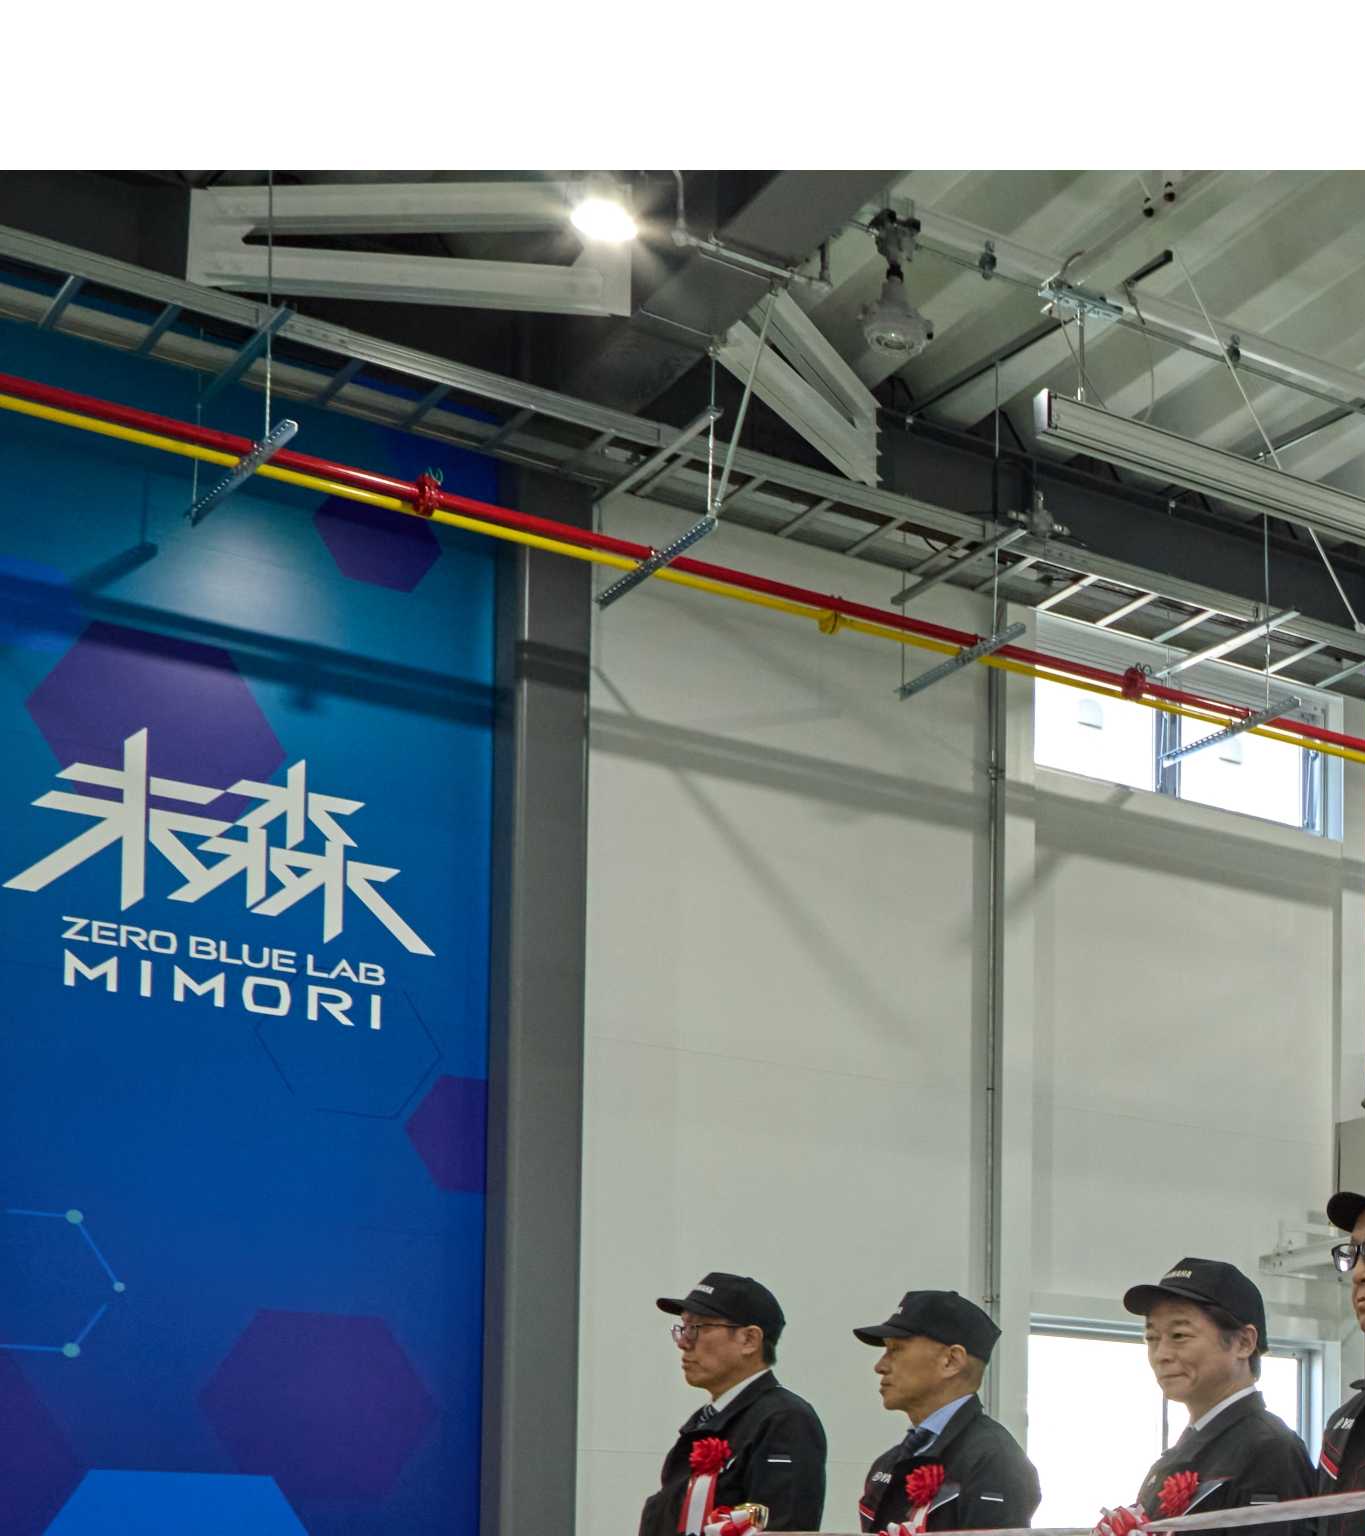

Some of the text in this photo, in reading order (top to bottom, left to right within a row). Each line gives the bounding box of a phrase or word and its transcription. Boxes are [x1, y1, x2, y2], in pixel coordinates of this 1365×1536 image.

[61, 916, 386, 986] ZERO BLUE LAB
[63, 949, 382, 1030] MIMORI
